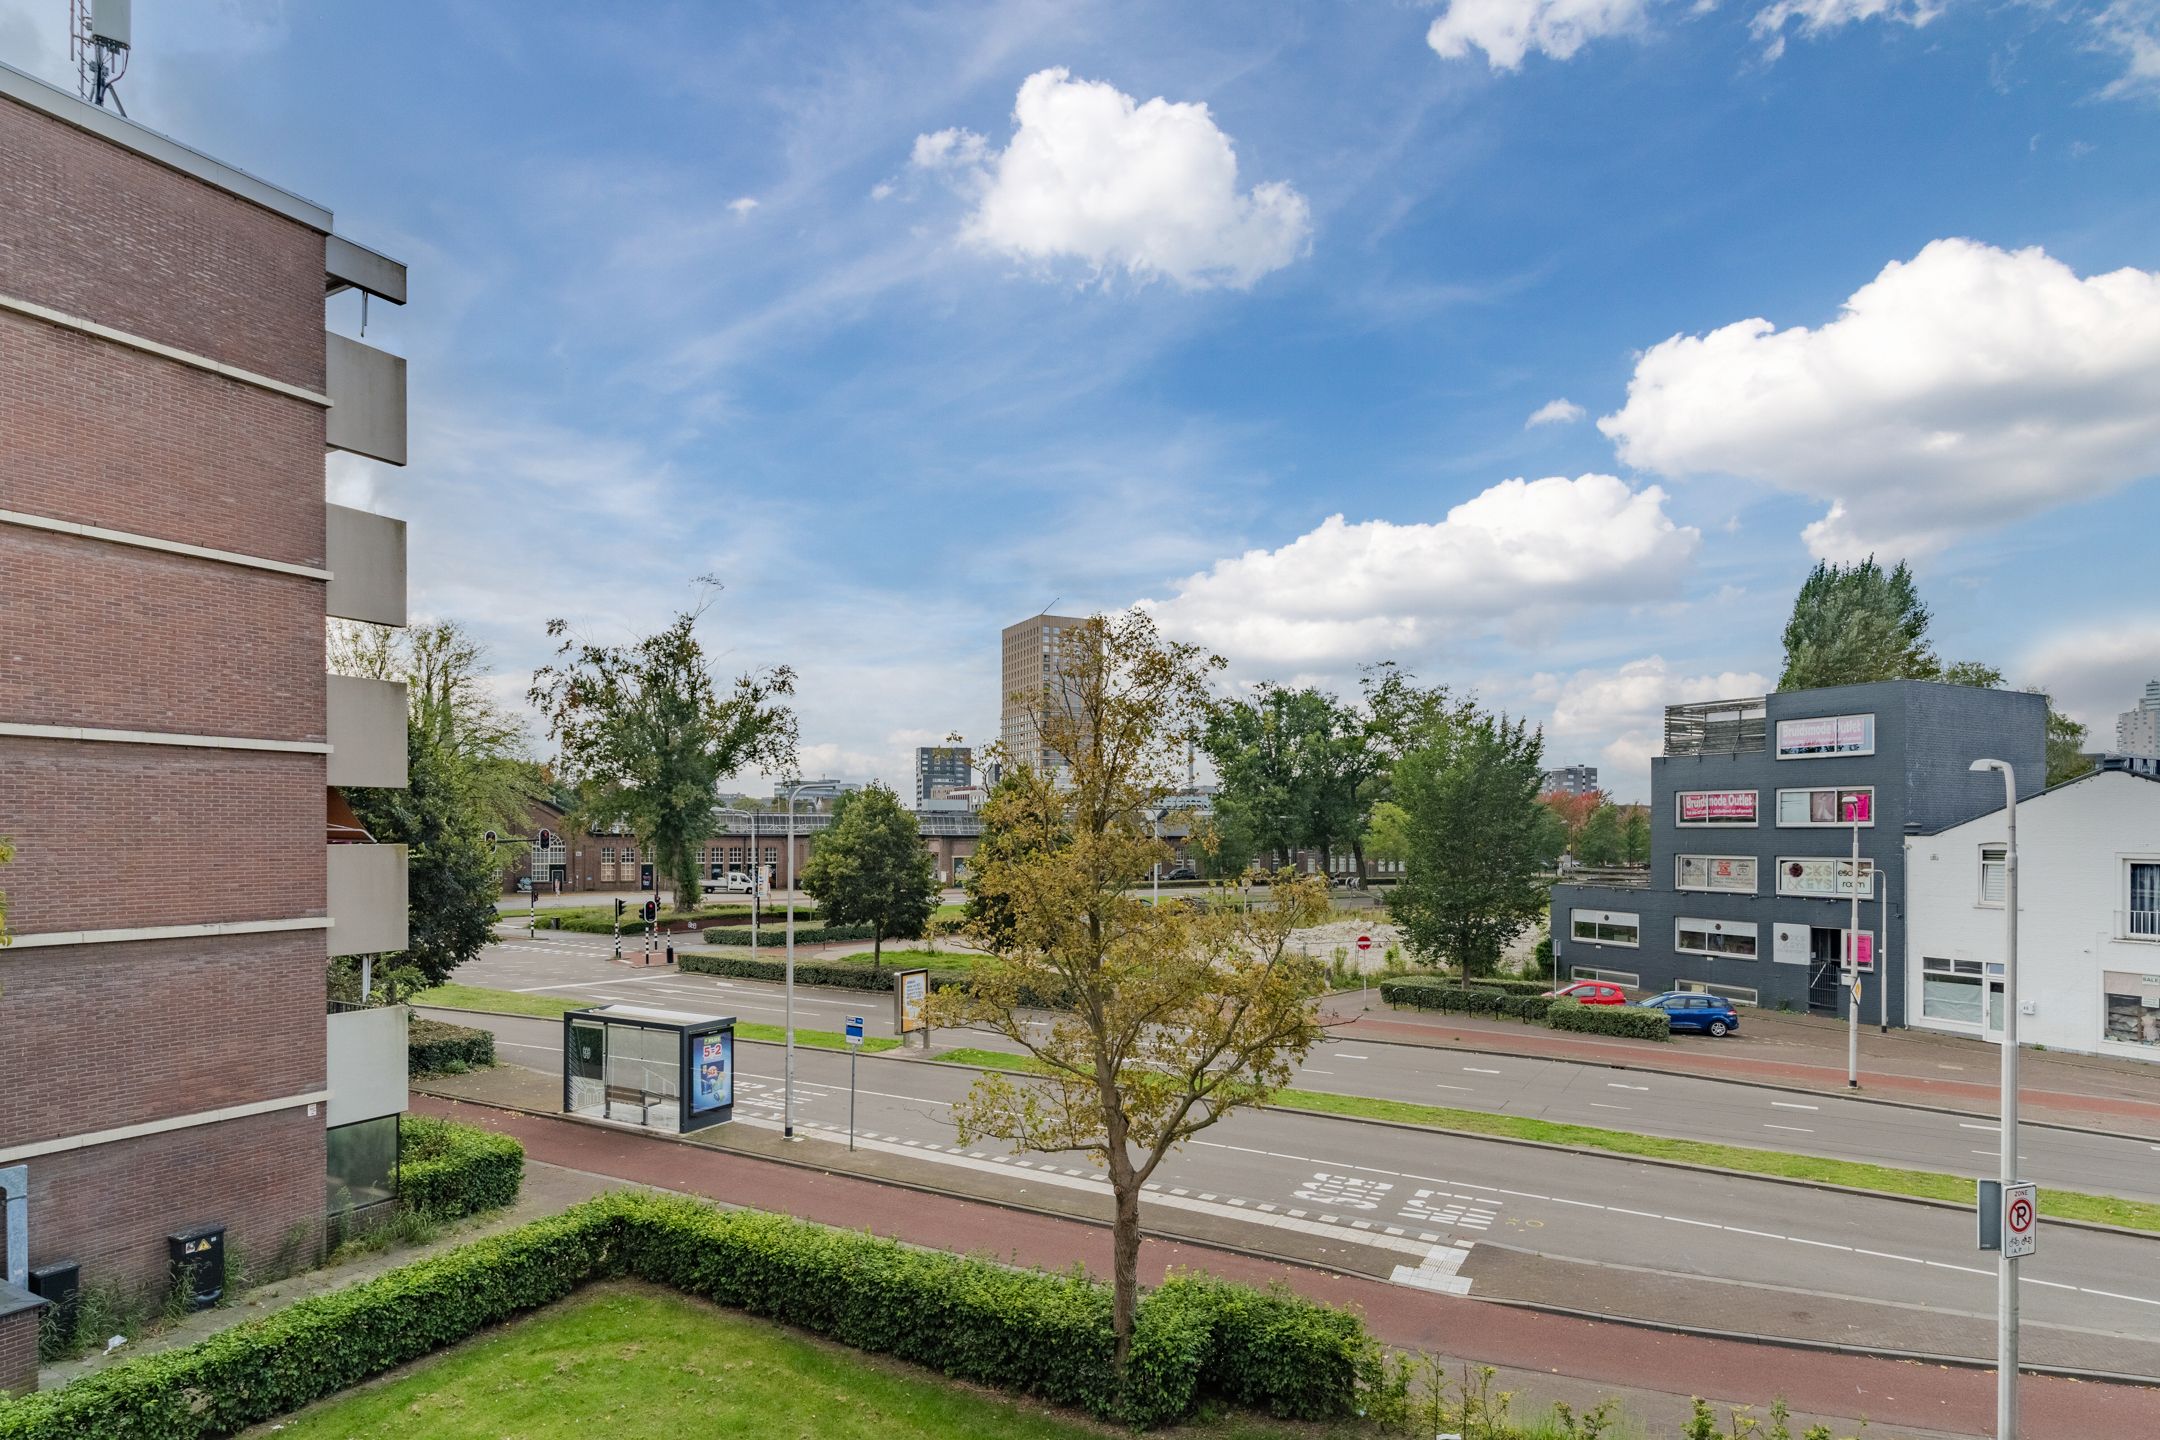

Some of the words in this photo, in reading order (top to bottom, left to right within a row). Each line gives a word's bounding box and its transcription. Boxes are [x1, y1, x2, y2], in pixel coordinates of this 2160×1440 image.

[1783, 722, 1831, 737] Bruidsmode
[1728, 794, 1753, 807] Outlet
[1838, 870, 1870, 878] escpe
